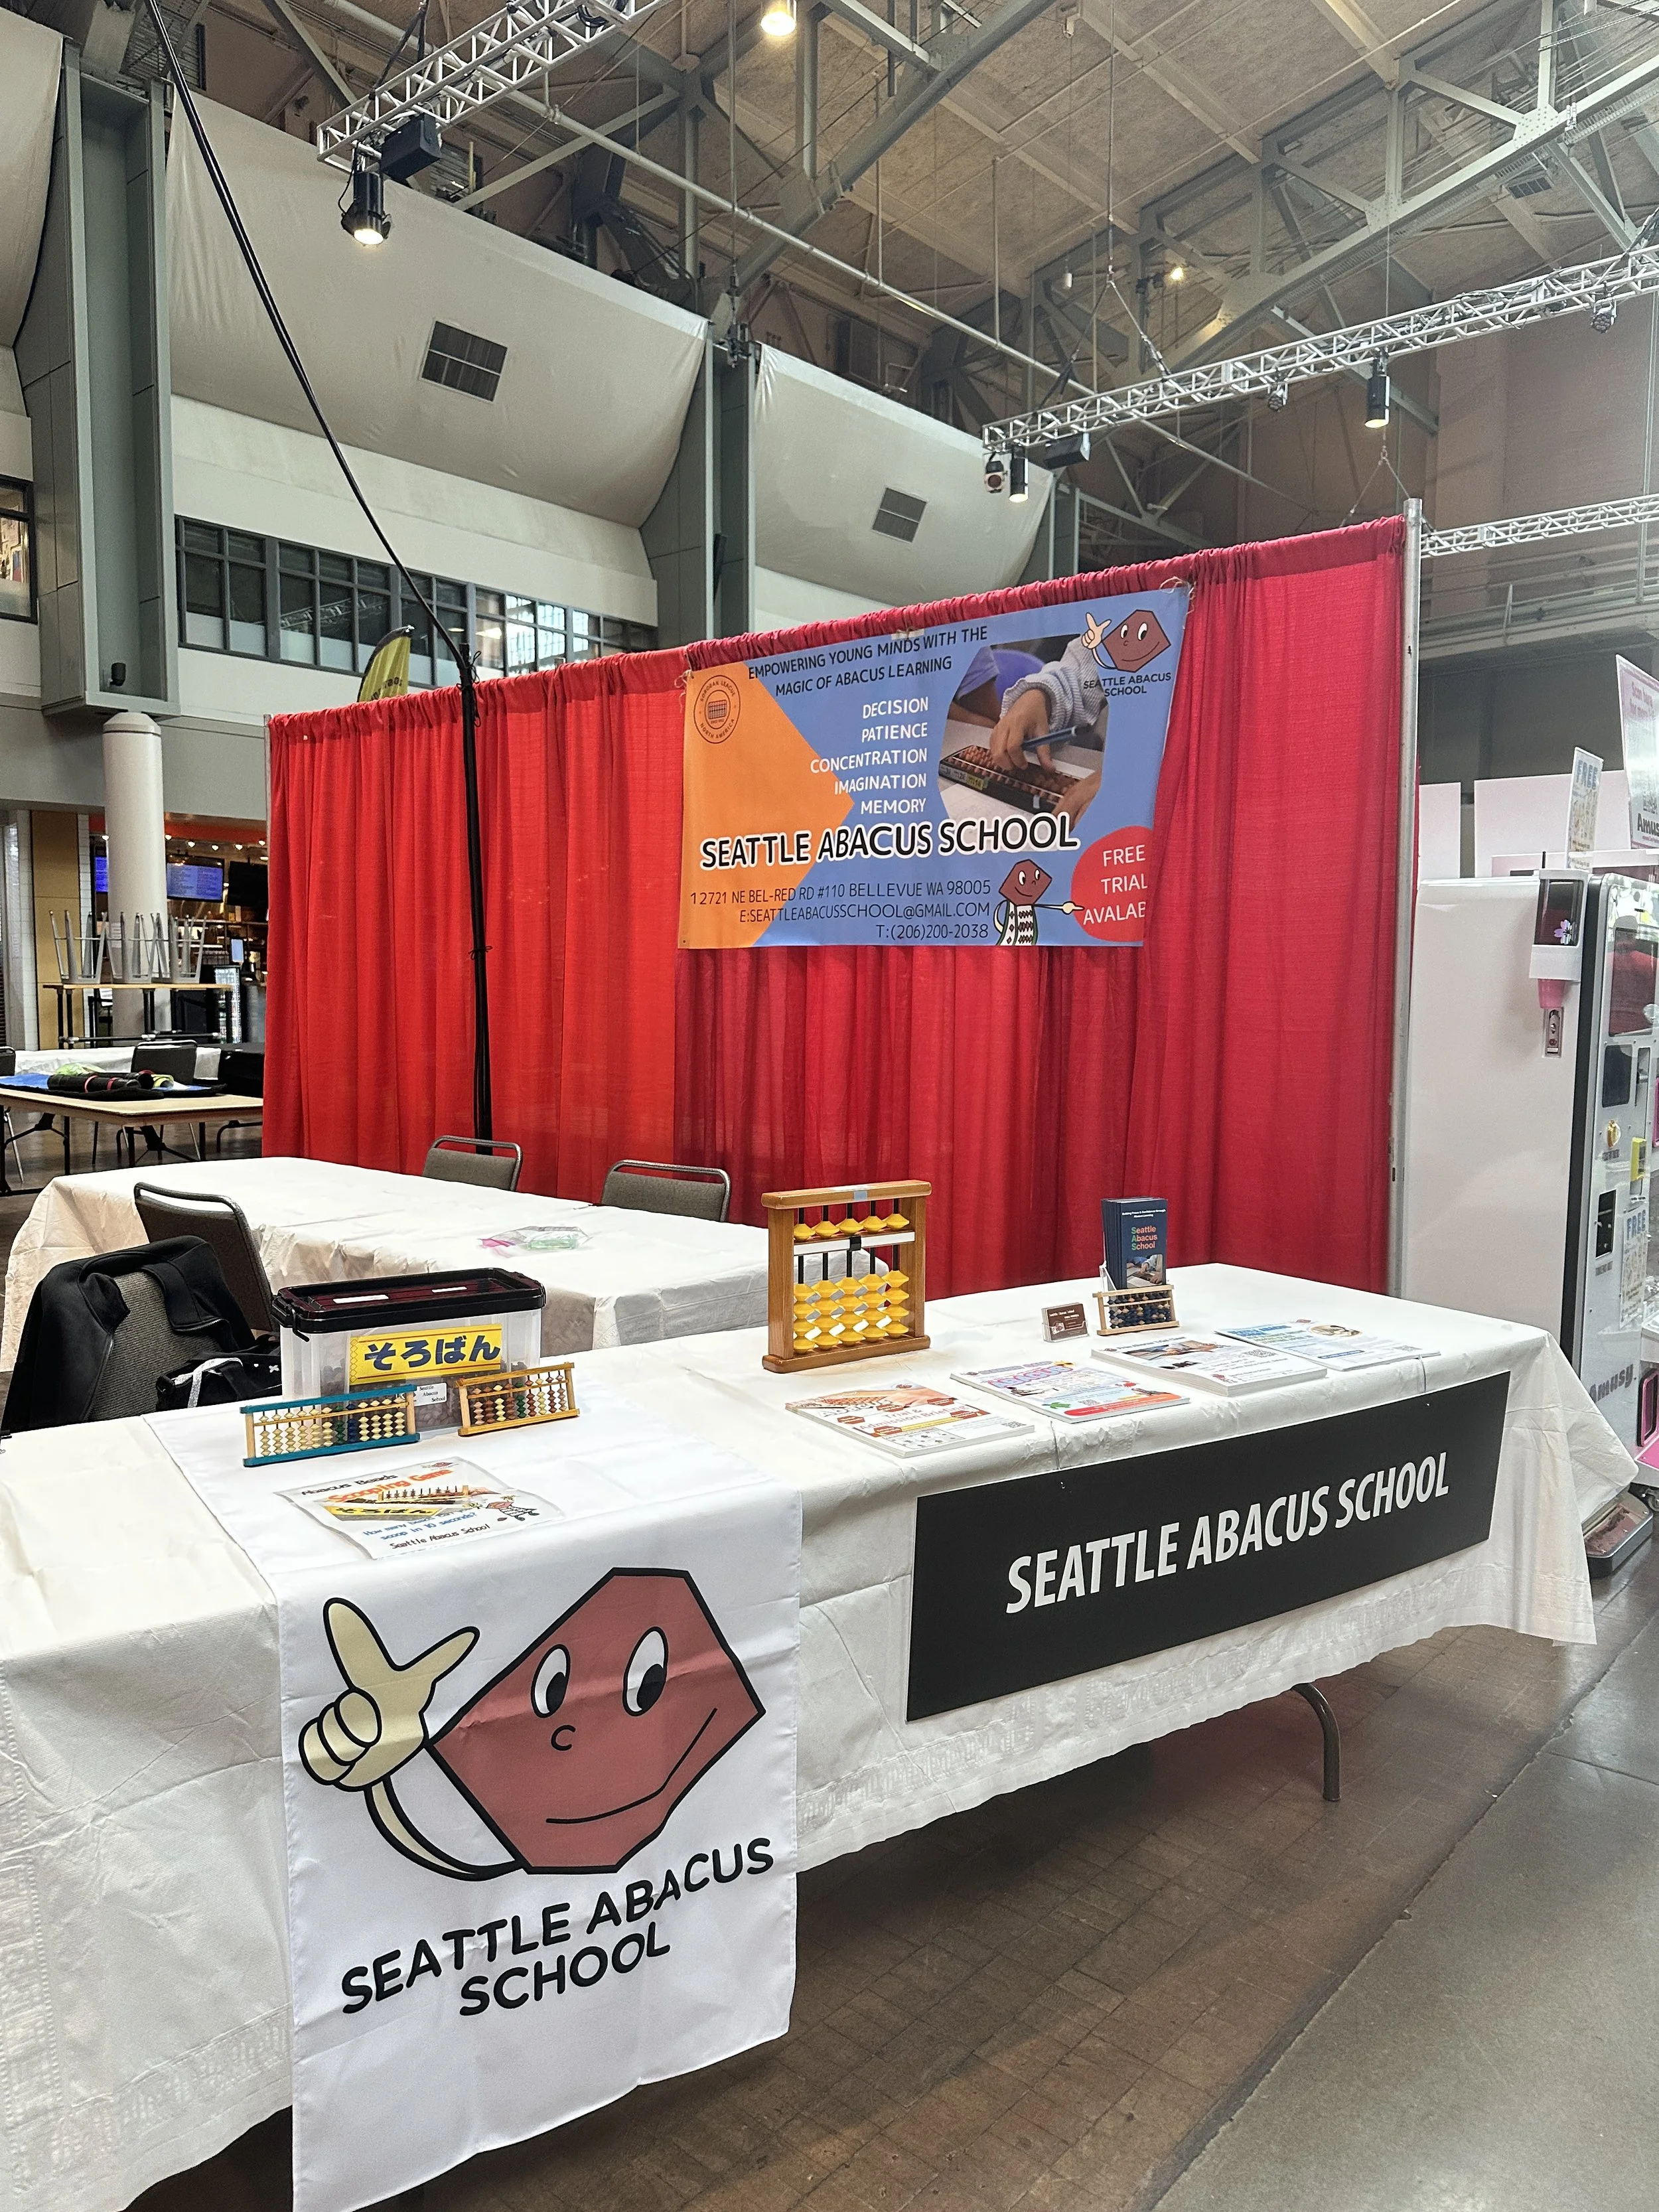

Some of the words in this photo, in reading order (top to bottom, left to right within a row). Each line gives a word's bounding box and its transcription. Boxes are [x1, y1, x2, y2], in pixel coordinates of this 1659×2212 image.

[749, 654, 826, 680] EMPOWERING
[828, 645, 873, 665] YOUNG
[877, 636, 920, 657] MINDS
[923, 630, 956, 650] WITH
[961, 626, 987, 642] THE
[775, 679, 813, 697] MAGIC
[816, 676, 832, 690] OF
[835, 666, 885, 686] ABACUS
[889, 656, 952, 678] LEARNING
[1083, 676, 1126, 690] SEATTLE
[1128, 672, 1171, 684] ABACUS
[1104, 686, 1147, 697] SCHOOL
[863, 697, 928, 719] DECISION
[715, 719, 735, 739] AMERICA
[861, 722, 928, 743] PATIENCE
[810, 748, 927, 773] CONCENTRATION
[835, 773, 926, 795] IMAGINATION
[1577, 759, 1598, 790] FREE
[861, 798, 926, 815] MEMORY
[701, 832, 810, 869] SEATTLE
[818, 823, 931, 862] ABACUS
[939, 815, 1078, 854] SCHOOL
[1103, 844, 1146, 867] FREE
[690, 891, 727, 905] 12721
[732, 890, 746, 903] NE
[749, 887, 796, 903] BEL-RED
[799, 886, 814, 901] RD
[818, 883, 845, 899] #110
[849, 883, 922, 897] BELLEVUE
[926, 881, 944, 895] WA
[947, 879, 991, 895] 98005
[1101, 873, 1147, 895] TRIAL
[740, 902, 989, 922] E:SEATTLEABACUSSCHOOL@GMAIL.COM
[1626, 1209, 1646, 1240] FREE
[1131, 1242, 1155, 1250] School
[364, 1335, 501, 1371] そろばん
[860, 1415, 921, 1430] Admission
[885, 1410, 911, 1418] Trial
[328, 1479, 412, 1503] Scooping
[407, 1469, 454, 1481] Game
[380, 1530, 408, 1540] scoop
[439, 1512, 477, 1525] seconds?
[390, 1538, 427, 1550] Seattle
[429, 1531, 459, 1542] Abacus
[463, 1523, 490, 1534] School
[1006, 1522, 1179, 1615] SEATTLE
[1187, 1485, 1330, 1570] ABACUS
[1336, 1451, 1449, 1529] SCHOOL
[341, 1902, 571, 2015] SEATTLE
[587, 1837, 774, 1937] ABACUS
[459, 1923, 670, 2016] SCHOOL
